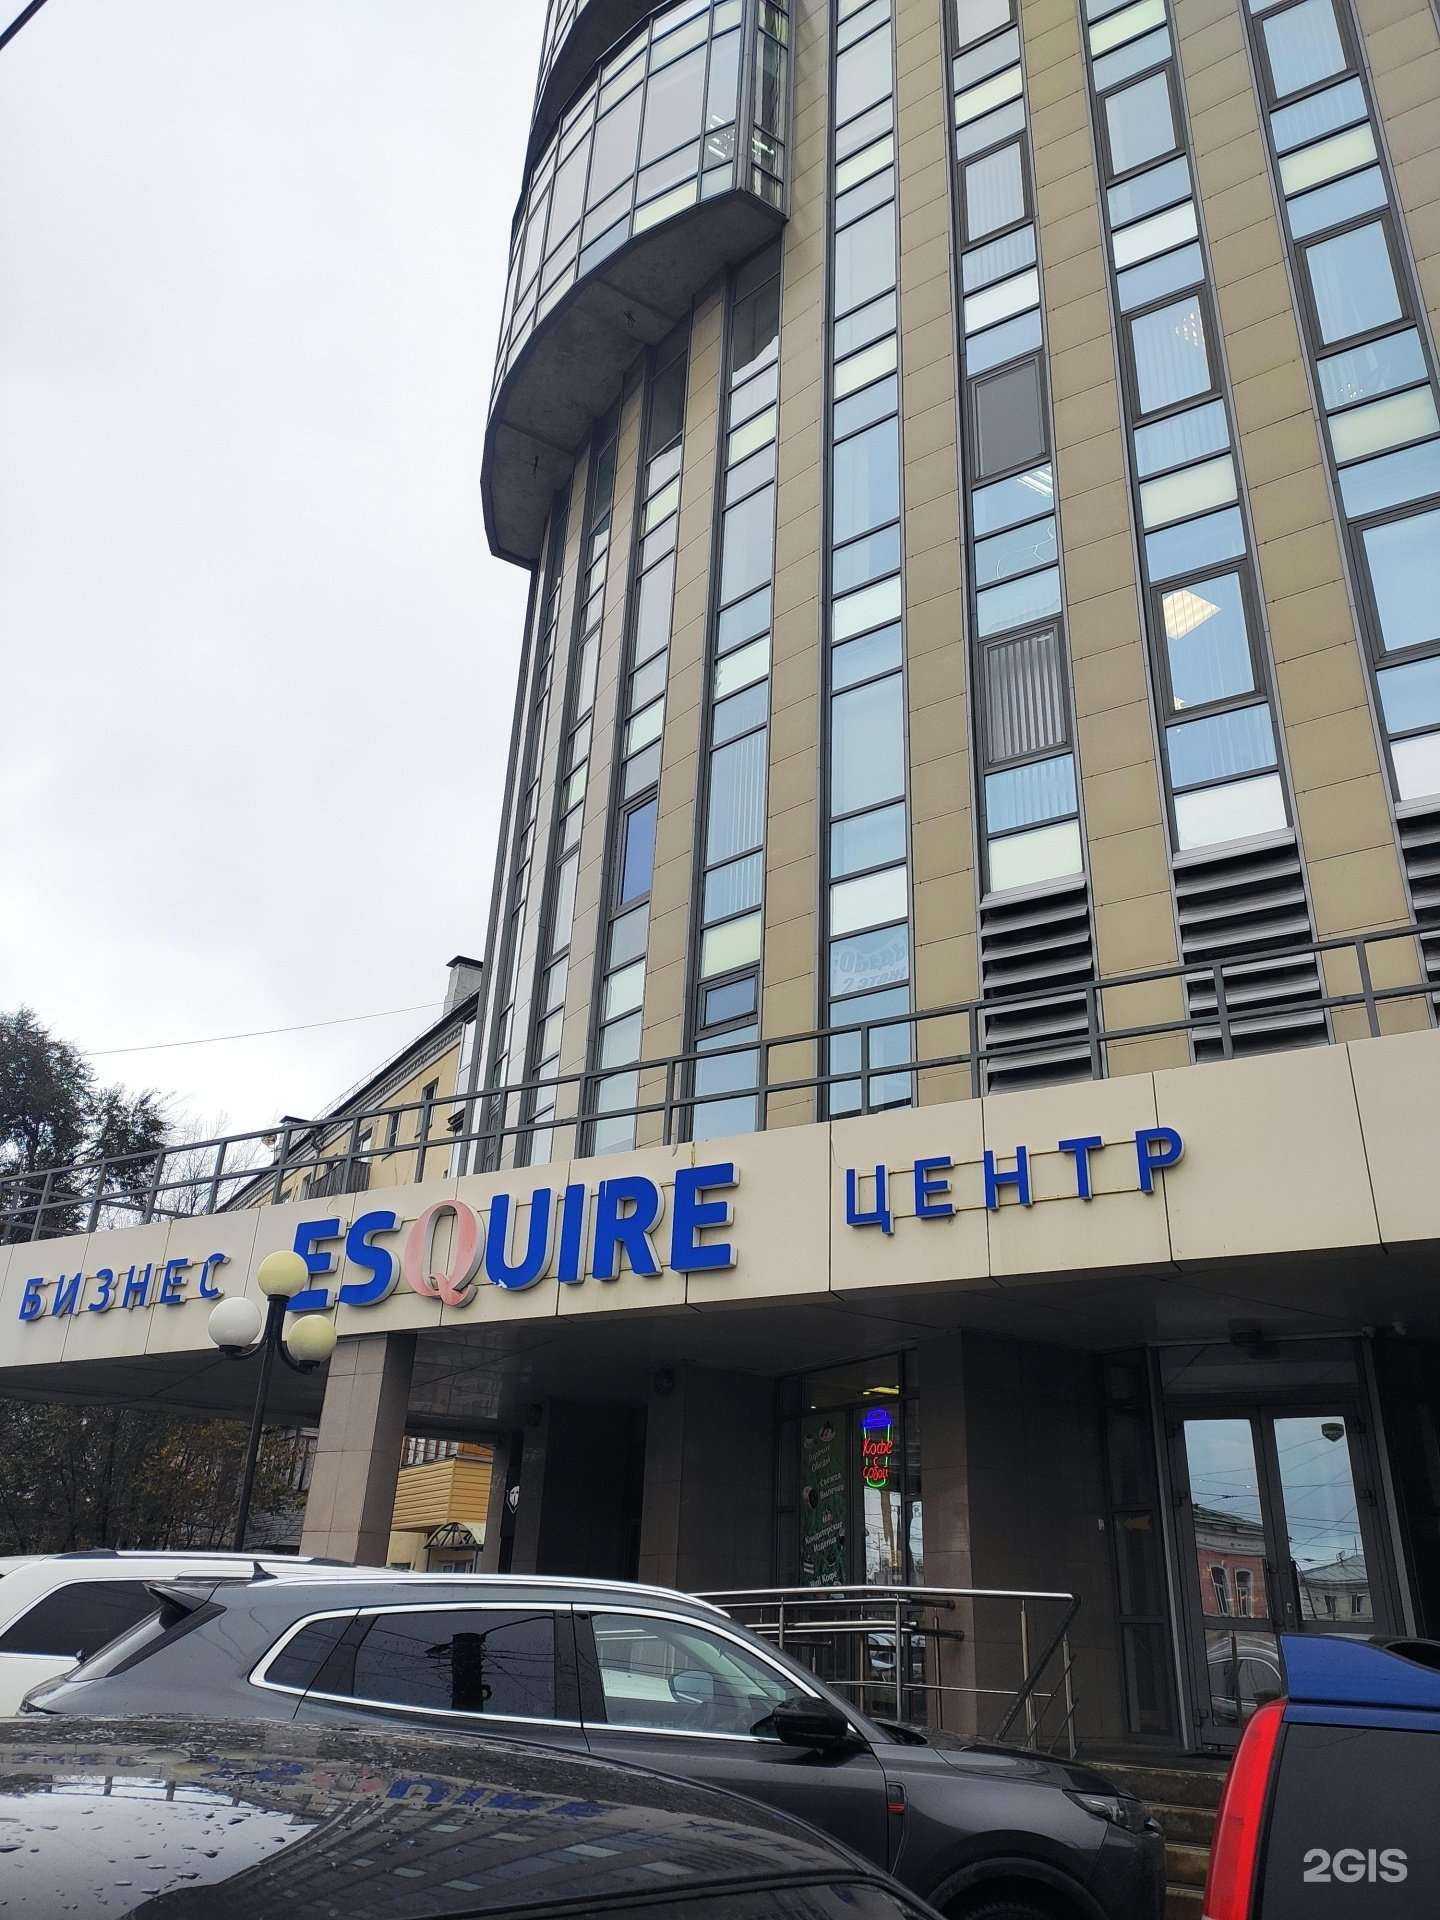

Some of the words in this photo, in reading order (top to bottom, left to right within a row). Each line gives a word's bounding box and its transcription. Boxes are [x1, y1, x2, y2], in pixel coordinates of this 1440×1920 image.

[19, 1252, 230, 1320] БИЗНЕС
[287, 1163, 740, 1311] ESQUIRE
[845, 1127, 1186, 1236] ЦЕНТР
